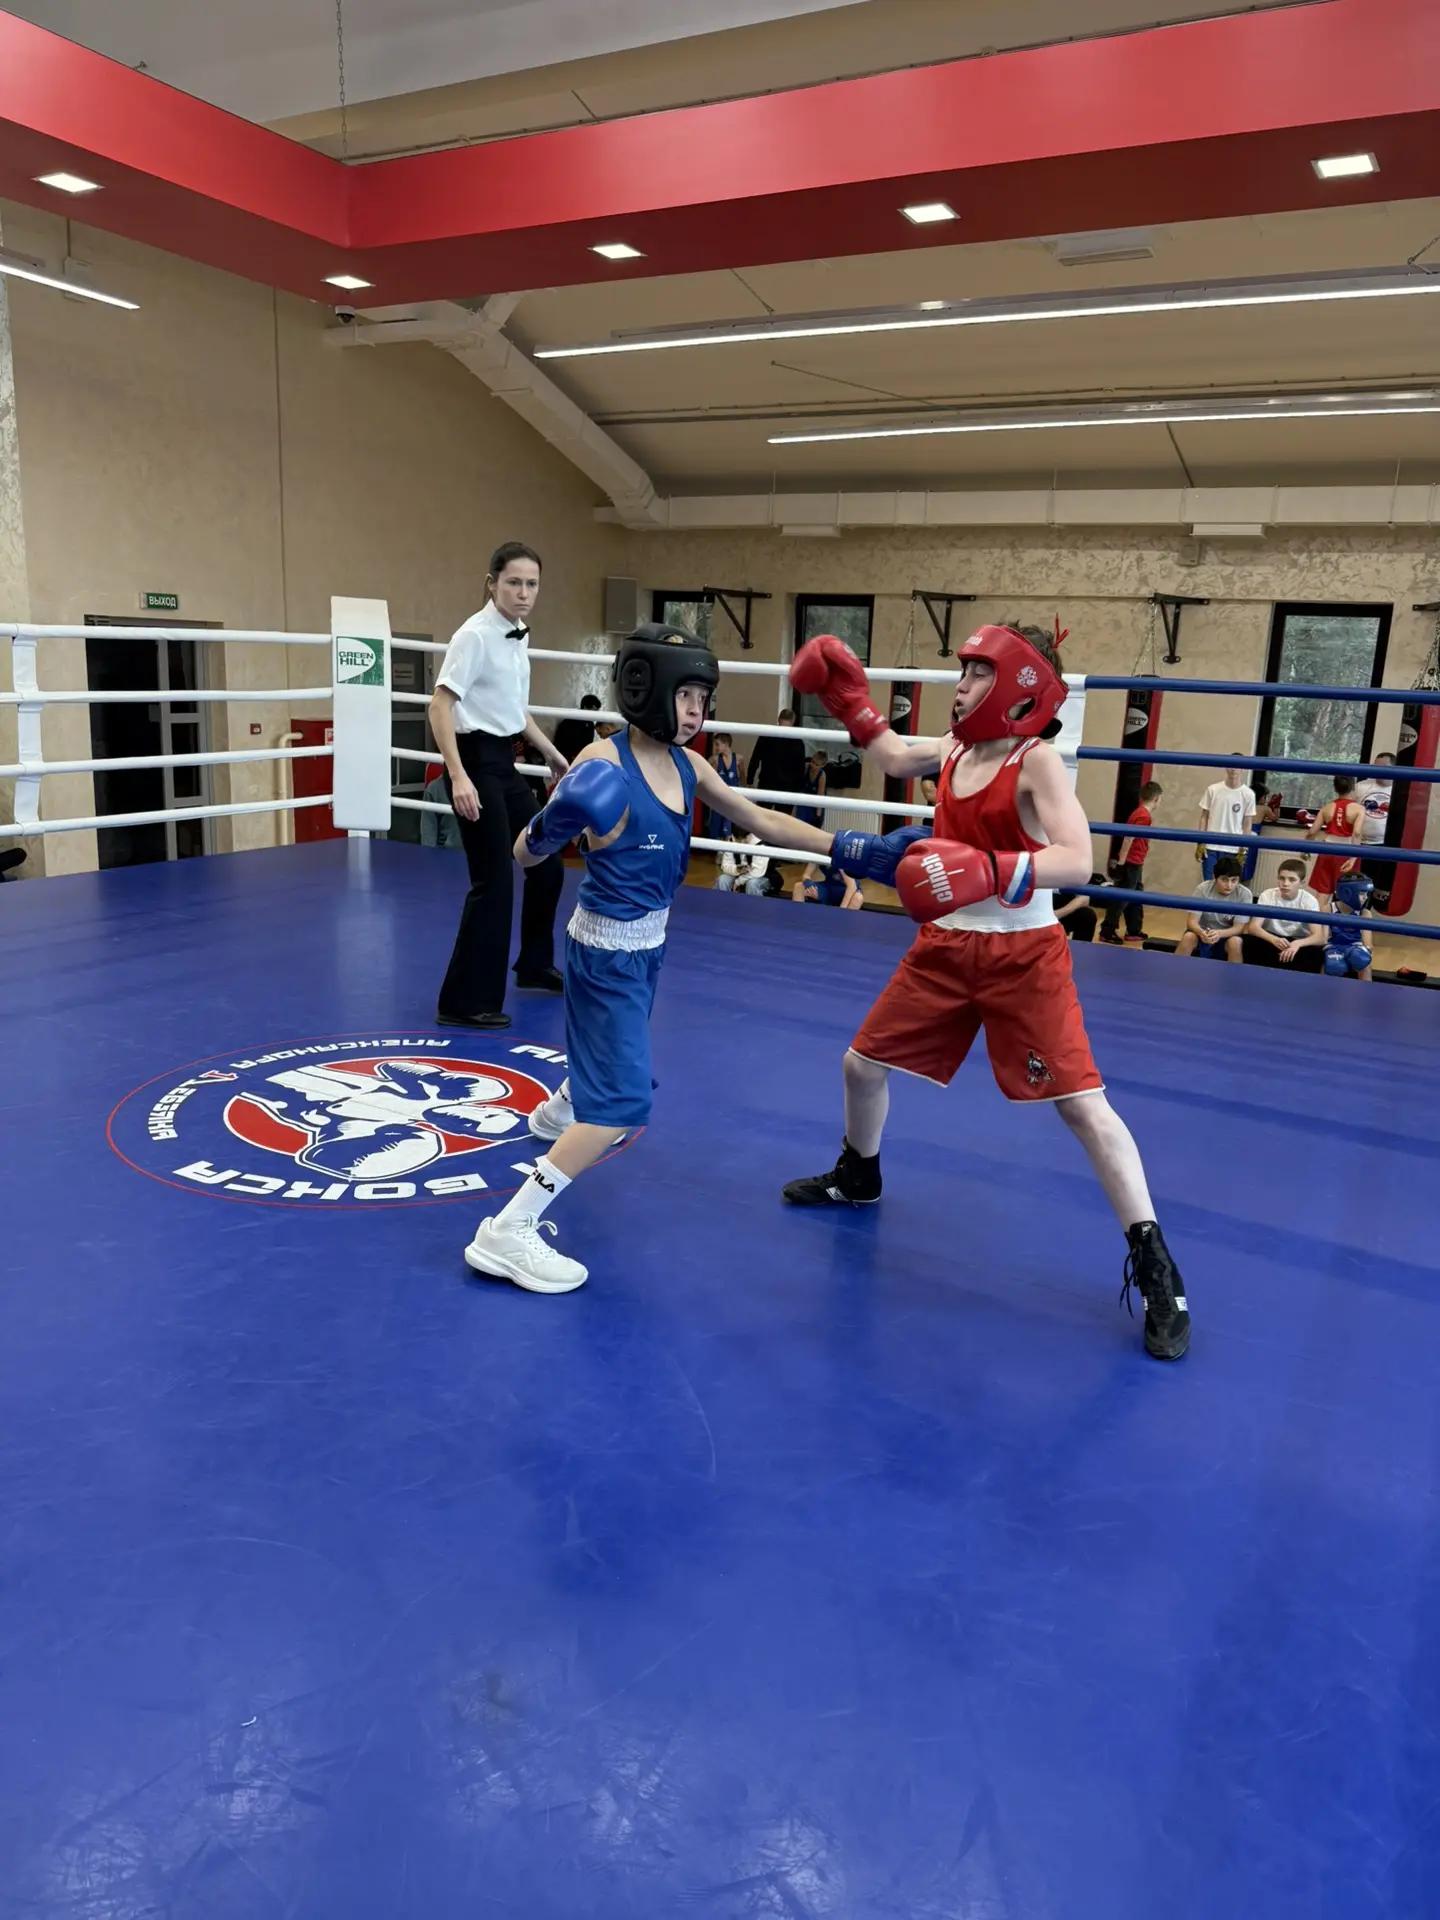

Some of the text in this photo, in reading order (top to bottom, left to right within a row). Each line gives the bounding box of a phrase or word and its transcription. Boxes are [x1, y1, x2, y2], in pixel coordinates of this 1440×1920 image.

[149, 595, 177, 608] ВЫХОД
[338, 651, 374, 660] GREEN
[339, 657, 370, 667] HILL
[921, 852, 954, 904] clinch
[229, 1039, 451, 1070] АЛЕКСАНДРА
[172, 1160, 489, 1201] БОКСА
[532, 1168, 555, 1194] FILA
